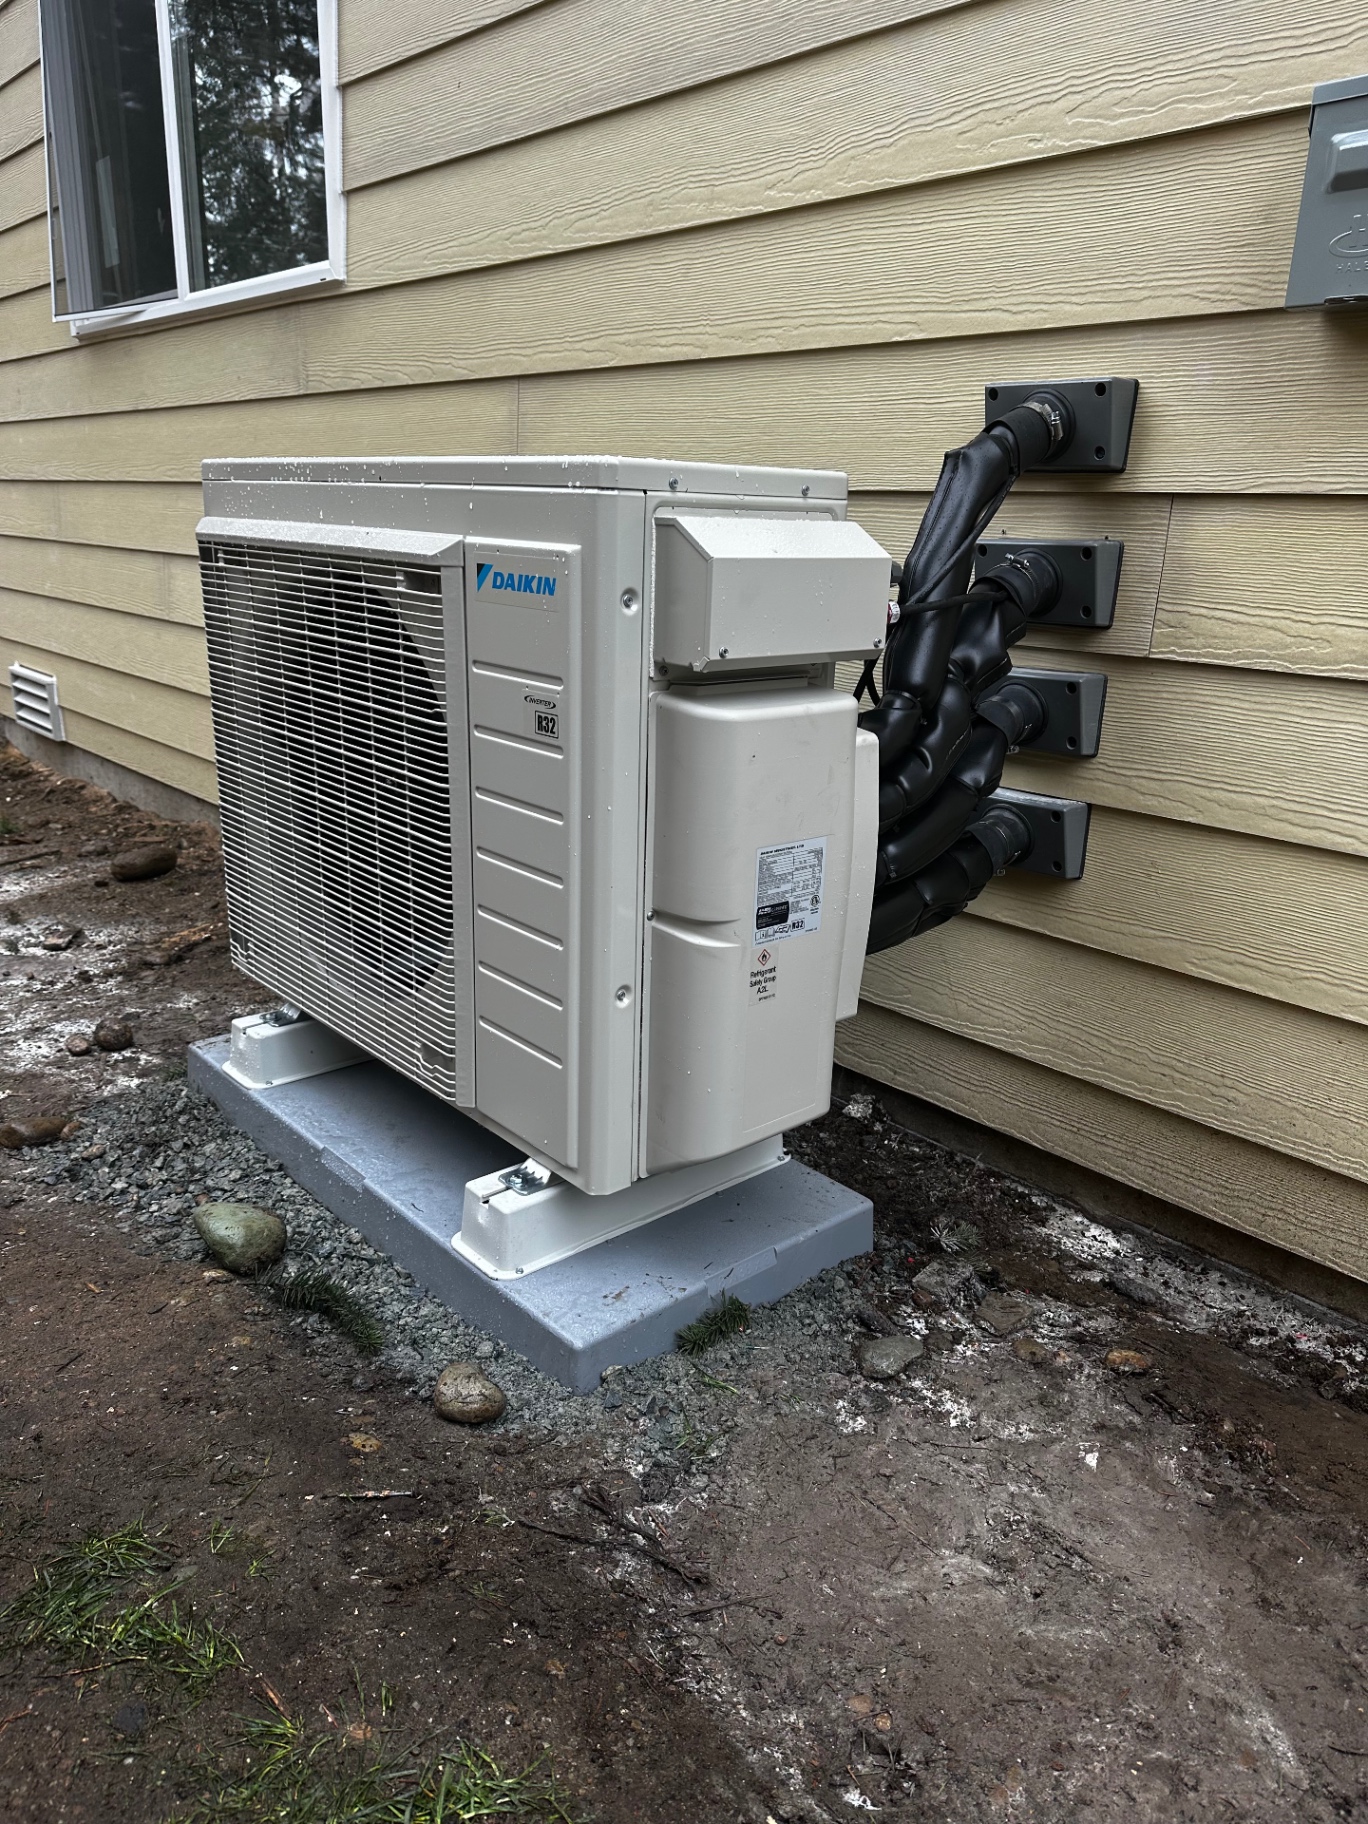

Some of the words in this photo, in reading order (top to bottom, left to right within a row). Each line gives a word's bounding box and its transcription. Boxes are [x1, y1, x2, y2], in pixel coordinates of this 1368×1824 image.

[492, 572, 557, 596] DAIKIN
[528, 696, 552, 707] INVERTER
[537, 714, 556, 735] R32
[791, 920, 804, 930] R32
[750, 966, 777, 978] Refrigerant
[749, 979, 763, 988] Safety
[763, 975, 777, 984] Group
[757, 985, 769, 994] A2L
